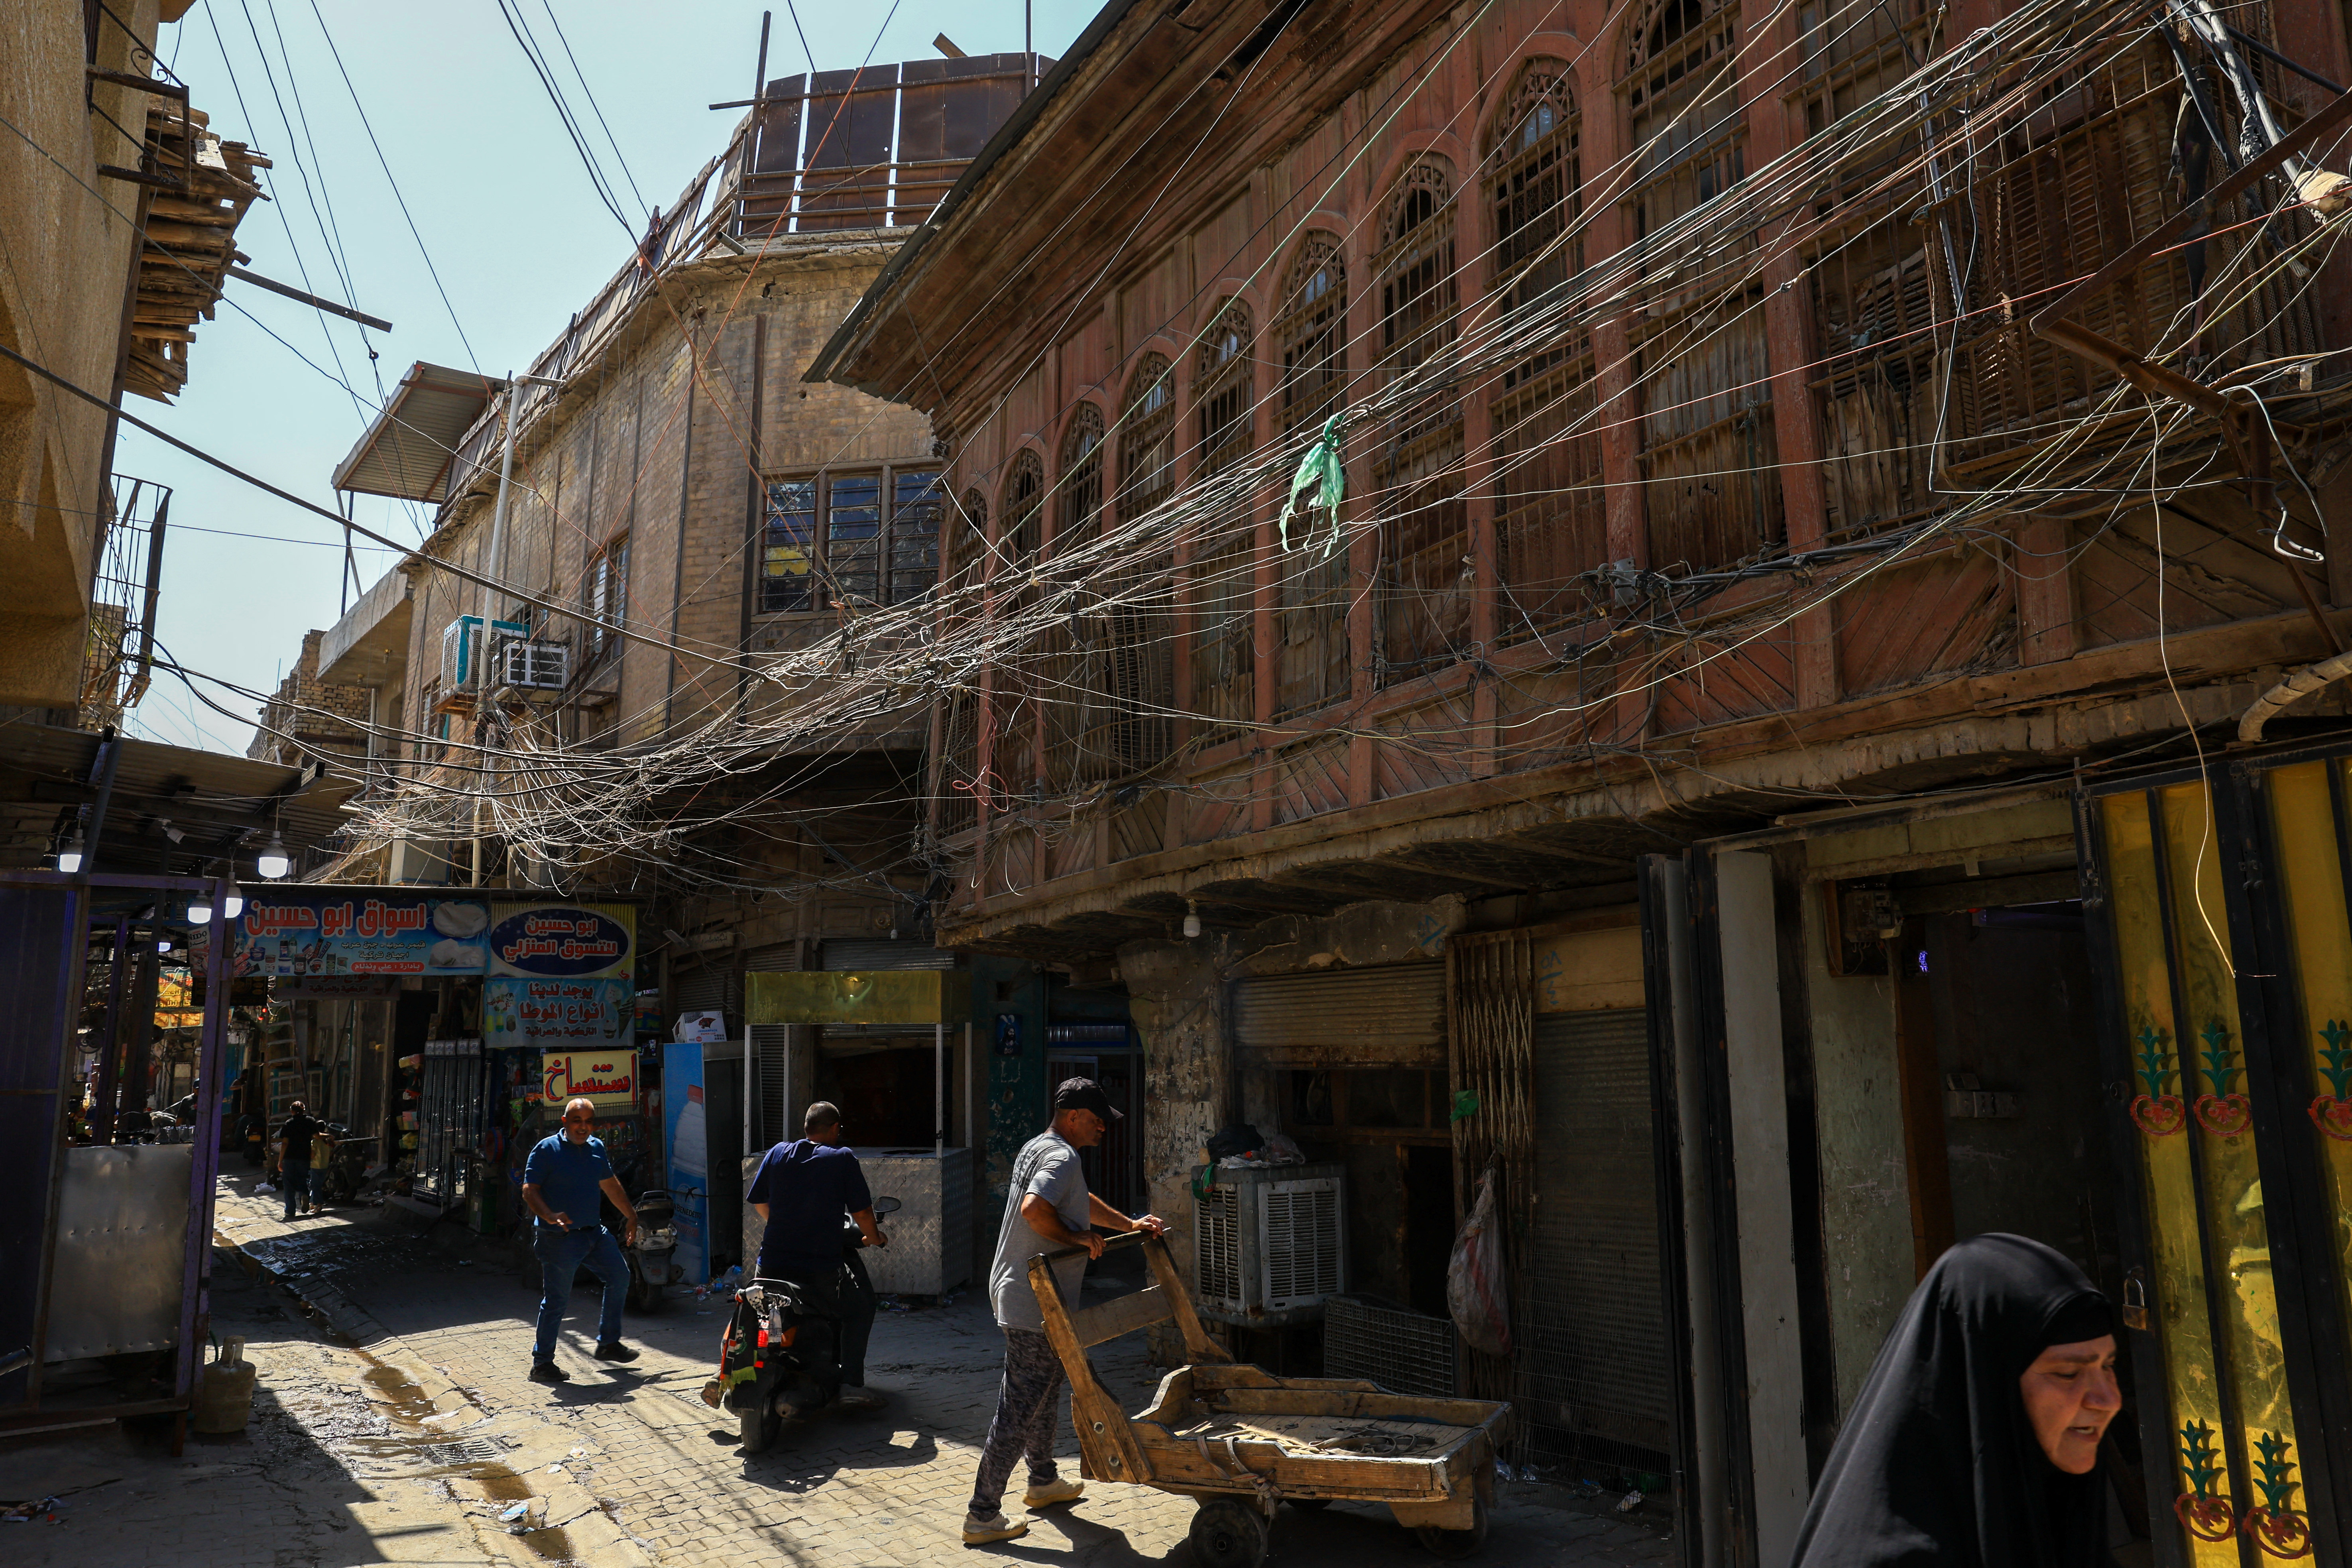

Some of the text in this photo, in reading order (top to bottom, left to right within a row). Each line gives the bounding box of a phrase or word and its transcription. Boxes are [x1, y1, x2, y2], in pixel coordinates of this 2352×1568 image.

[247, 901, 425, 937] اسواق ابو حسين
[527, 917, 596, 935] ابو حسين
[363, 941, 378, 950] جبن
[405, 940, 426, 949] قيمر
[505, 939, 617, 961] للتسوق المنزلي
[358, 950, 409, 960] اجبان تركية
[529, 982, 594, 1000] يوجد لدينا
[519, 1002, 605, 1024] انواع الموطا
[525, 1026, 597, 1037] التركية والعراقية
[677, 1204, 702, 1219] BENEDETTO
